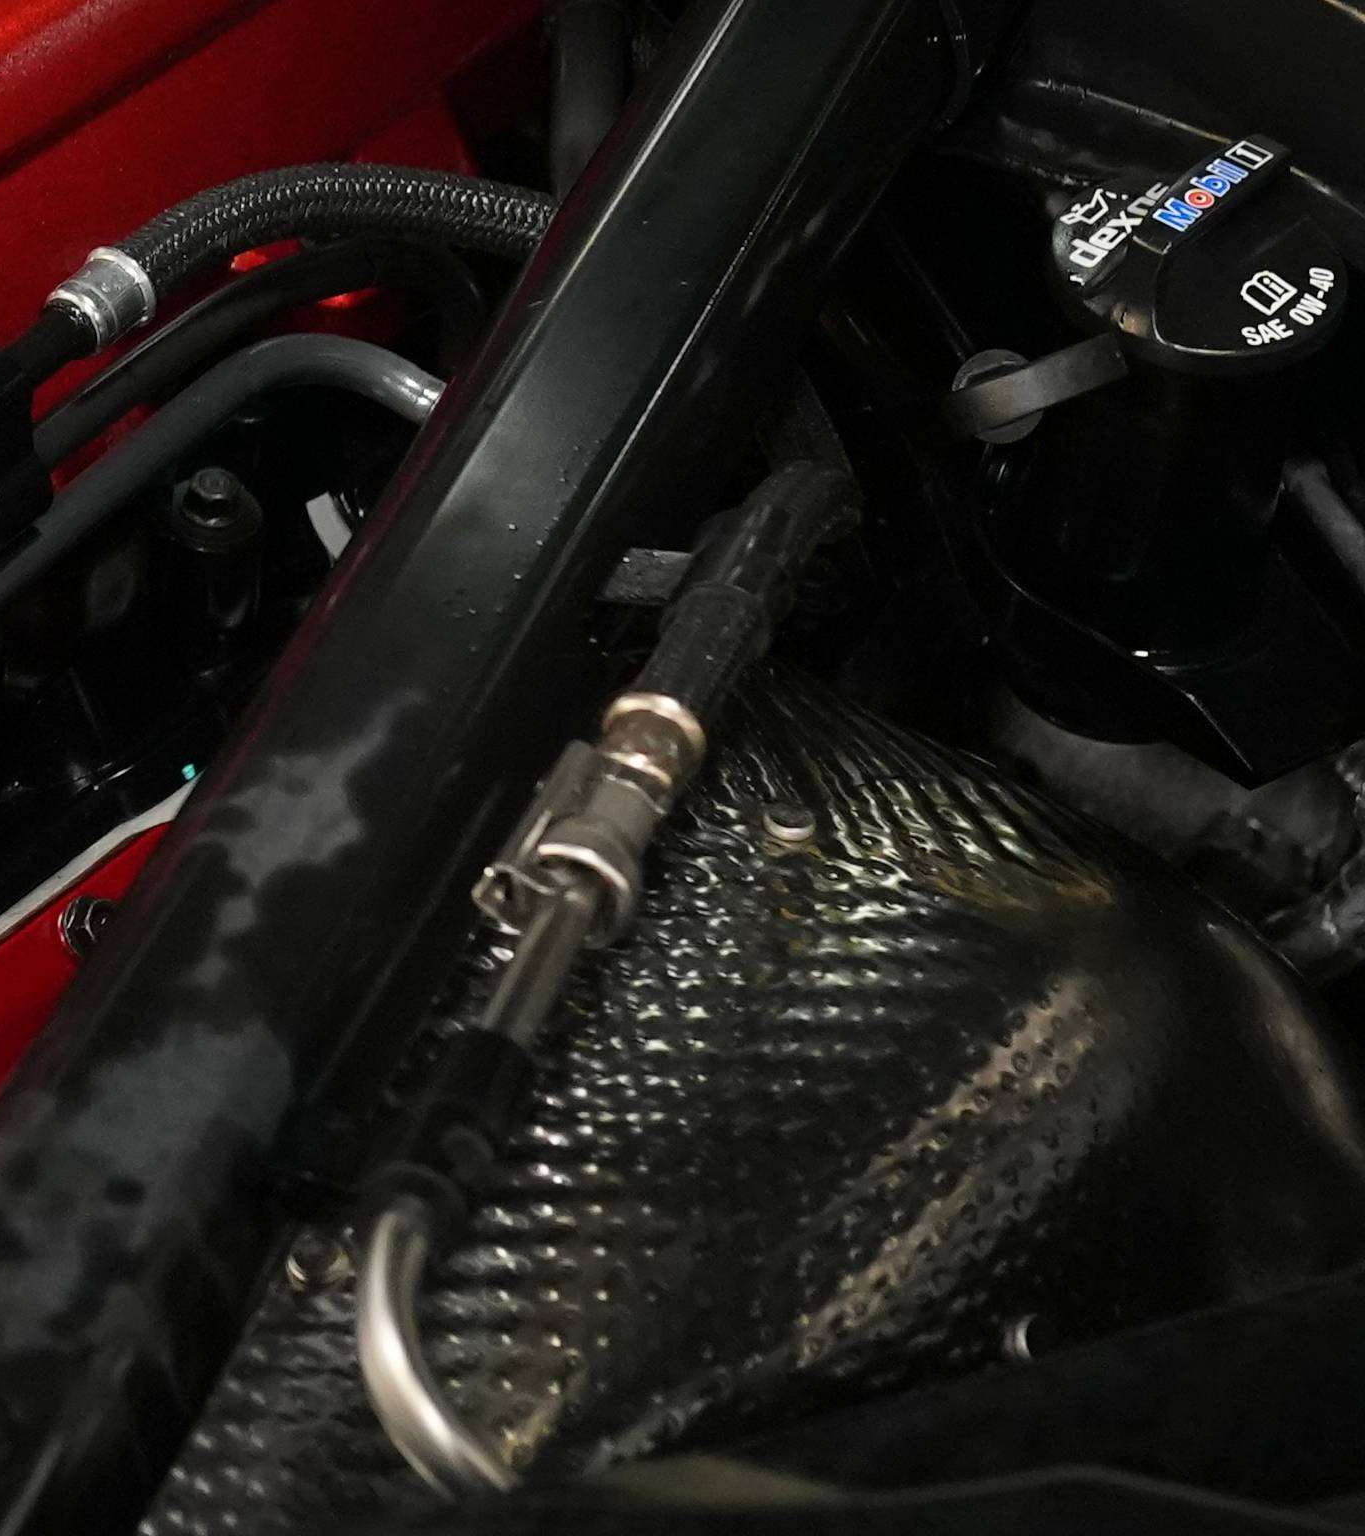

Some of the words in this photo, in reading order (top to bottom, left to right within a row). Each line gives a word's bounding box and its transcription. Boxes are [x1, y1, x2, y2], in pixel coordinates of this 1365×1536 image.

[1152, 158, 1250, 232] Mobil
[1240, 318, 1294, 346] SAE
[1289, 266, 1335, 326] 0W-40
